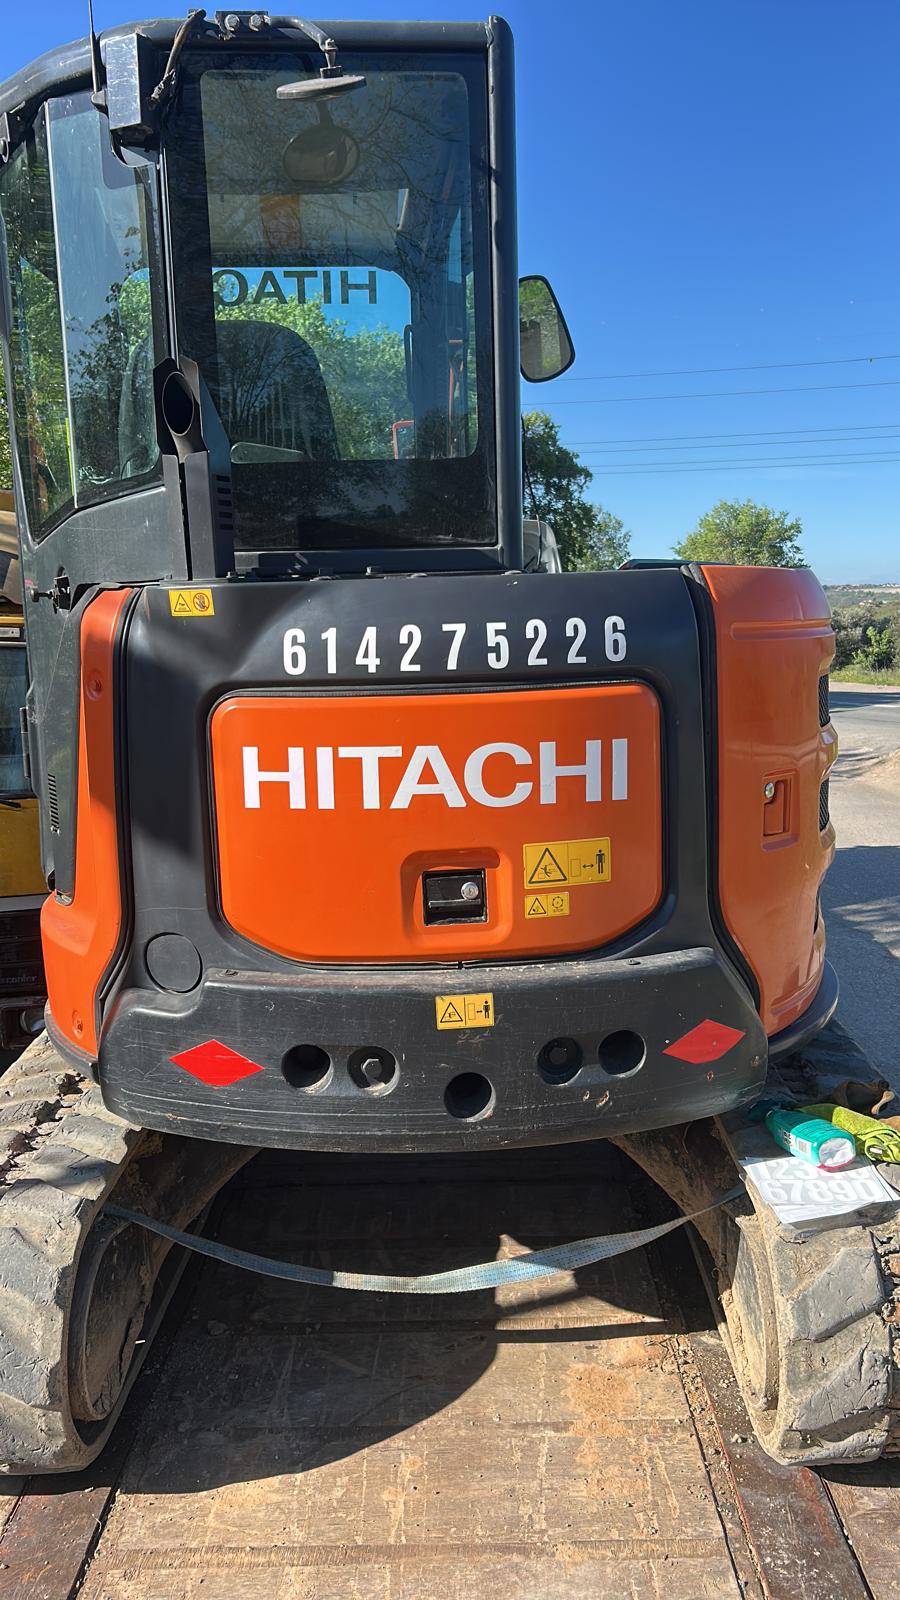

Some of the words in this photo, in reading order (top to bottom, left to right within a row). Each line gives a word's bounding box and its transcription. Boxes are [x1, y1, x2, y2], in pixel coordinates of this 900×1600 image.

[283, 616, 628, 675] 614275226
[242, 738, 628, 809] HITACHI
[763, 1180, 884, 1201] 67890
